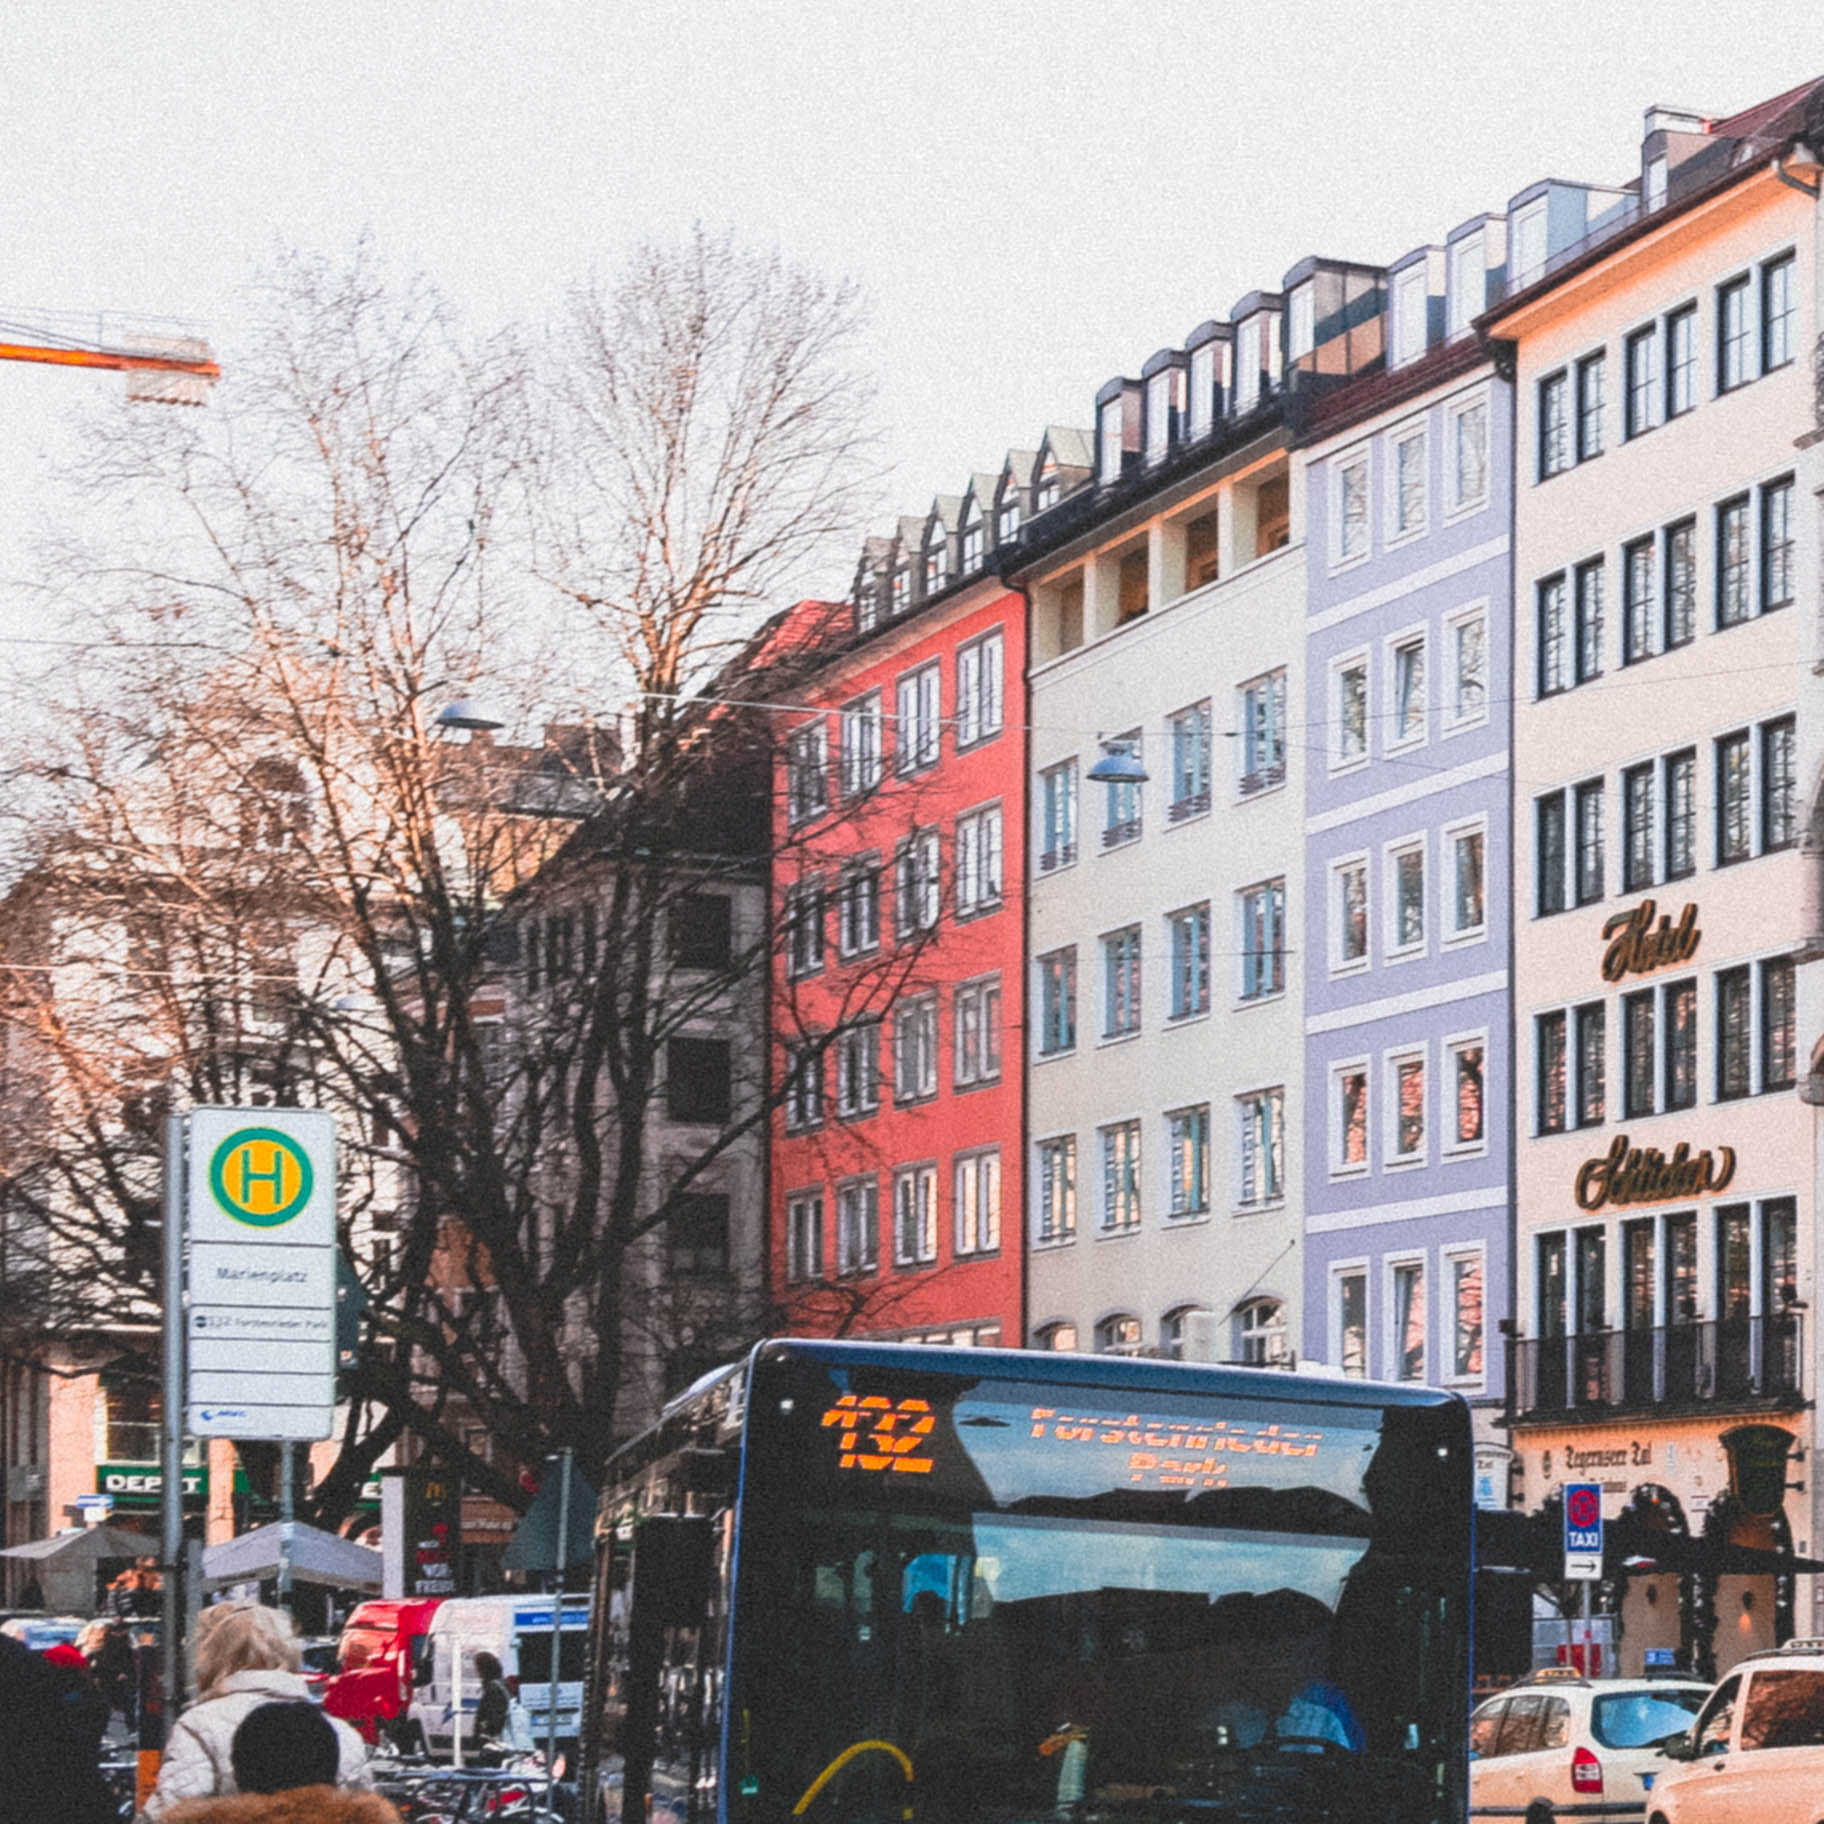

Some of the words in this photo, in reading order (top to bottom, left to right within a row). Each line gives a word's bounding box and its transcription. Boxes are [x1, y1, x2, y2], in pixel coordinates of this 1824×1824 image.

[1600, 898, 1702, 982] Hotel
[242, 1149, 283, 1205] H
[216, 1267, 309, 1284] Marienplatz
[1631, 1440, 1652, 1466] Tal
[105, 1473, 202, 1493] DEPT
[1568, 1531, 1599, 1547] TAXI
